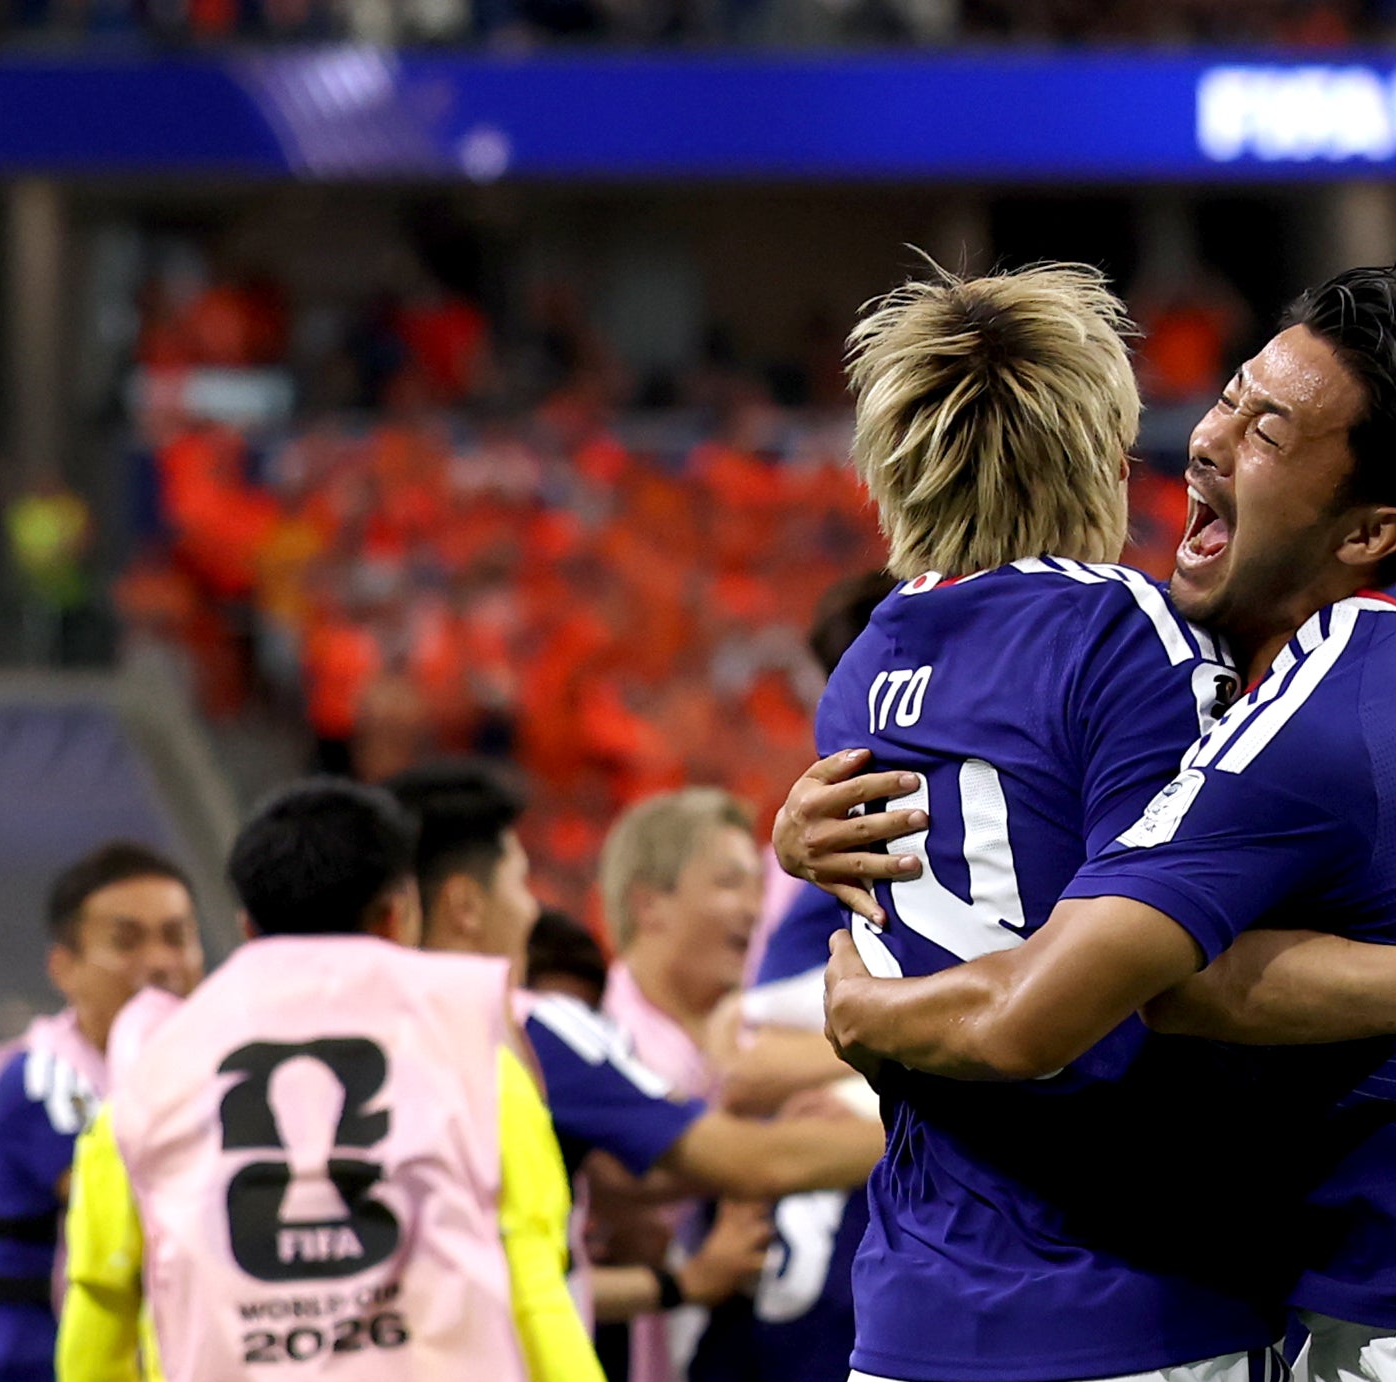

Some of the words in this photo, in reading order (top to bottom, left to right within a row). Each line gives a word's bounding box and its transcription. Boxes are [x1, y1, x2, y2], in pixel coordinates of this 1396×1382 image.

[1199, 65, 1390, 161] FIFA
[868, 665, 933, 734] ITO
[243, 1310, 410, 1363] 2026
